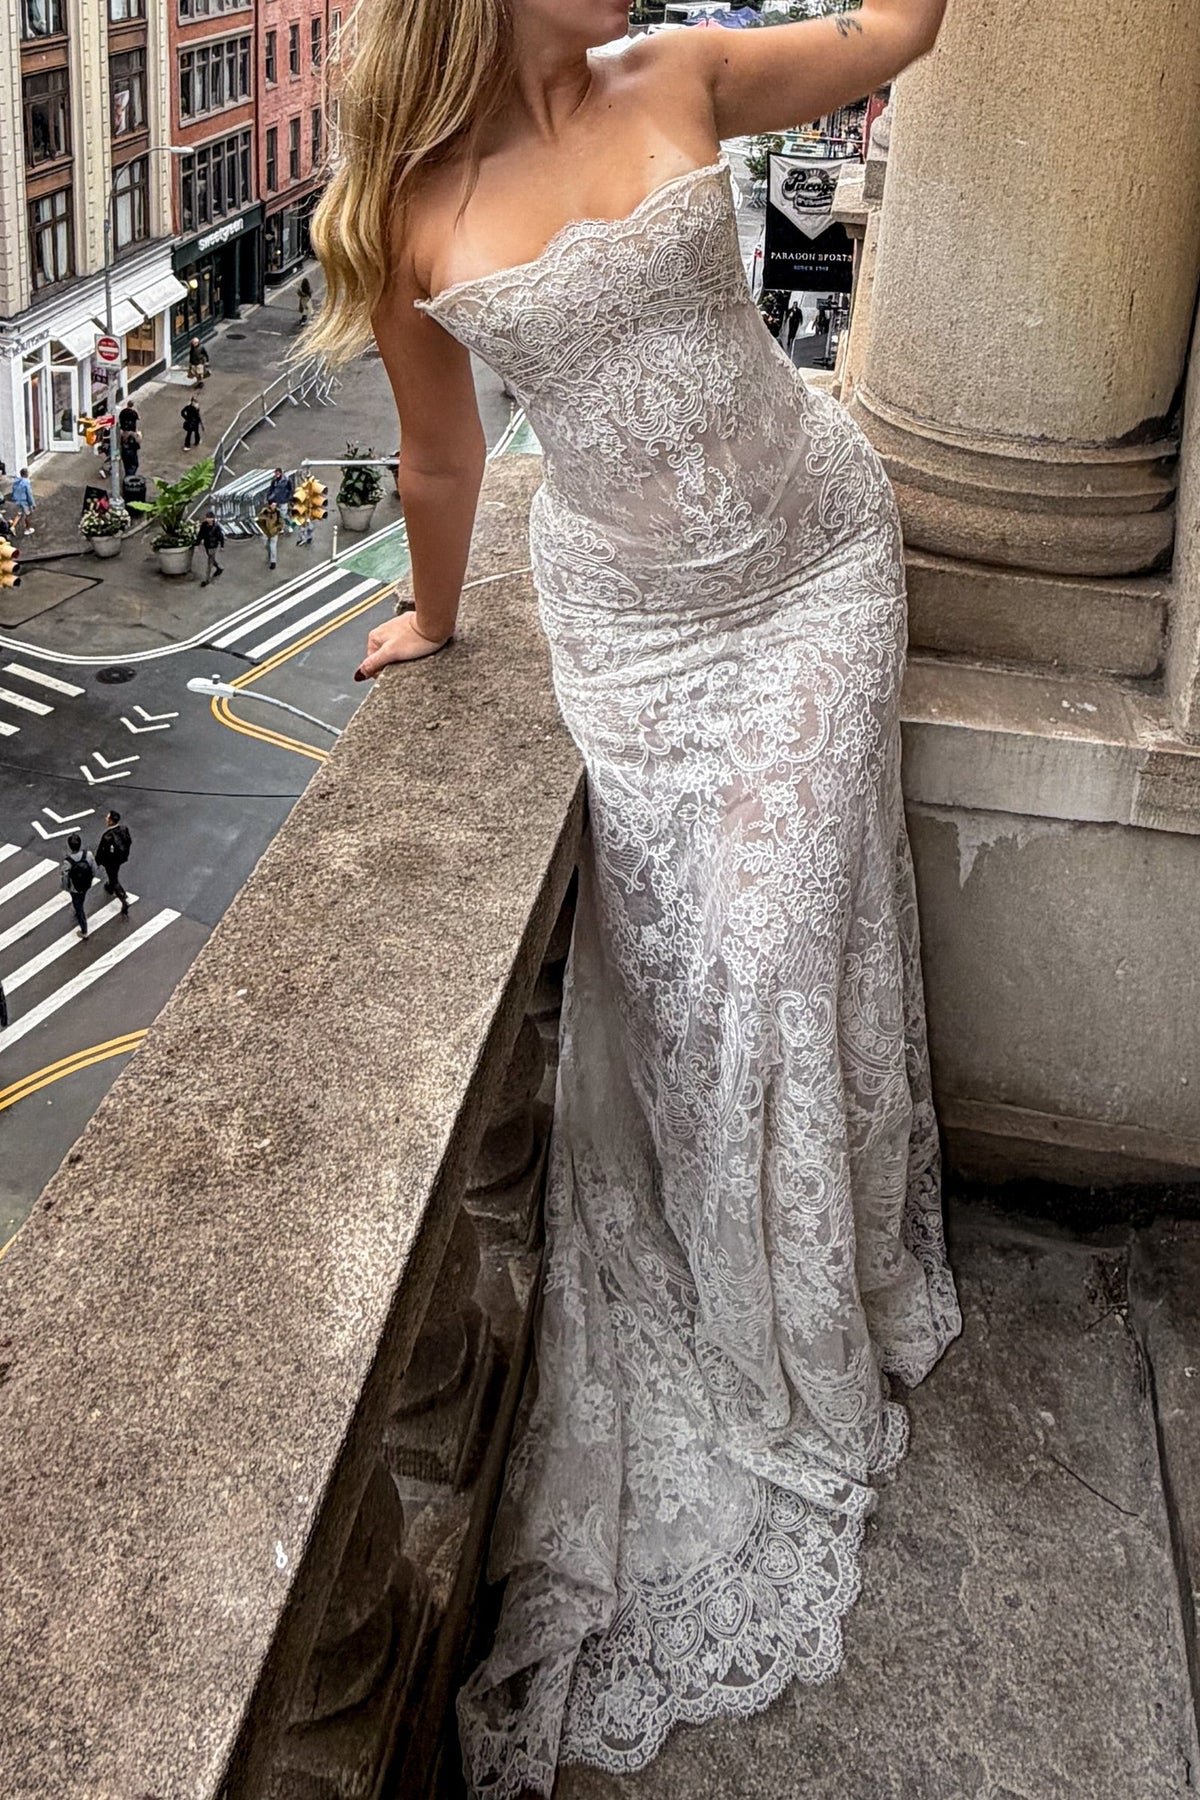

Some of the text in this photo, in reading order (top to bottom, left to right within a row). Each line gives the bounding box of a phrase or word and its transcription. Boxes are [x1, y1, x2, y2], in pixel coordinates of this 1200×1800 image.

[198, 217, 244, 251] sweetgreen
[770, 252, 853, 262] PARAGON SPORTS
